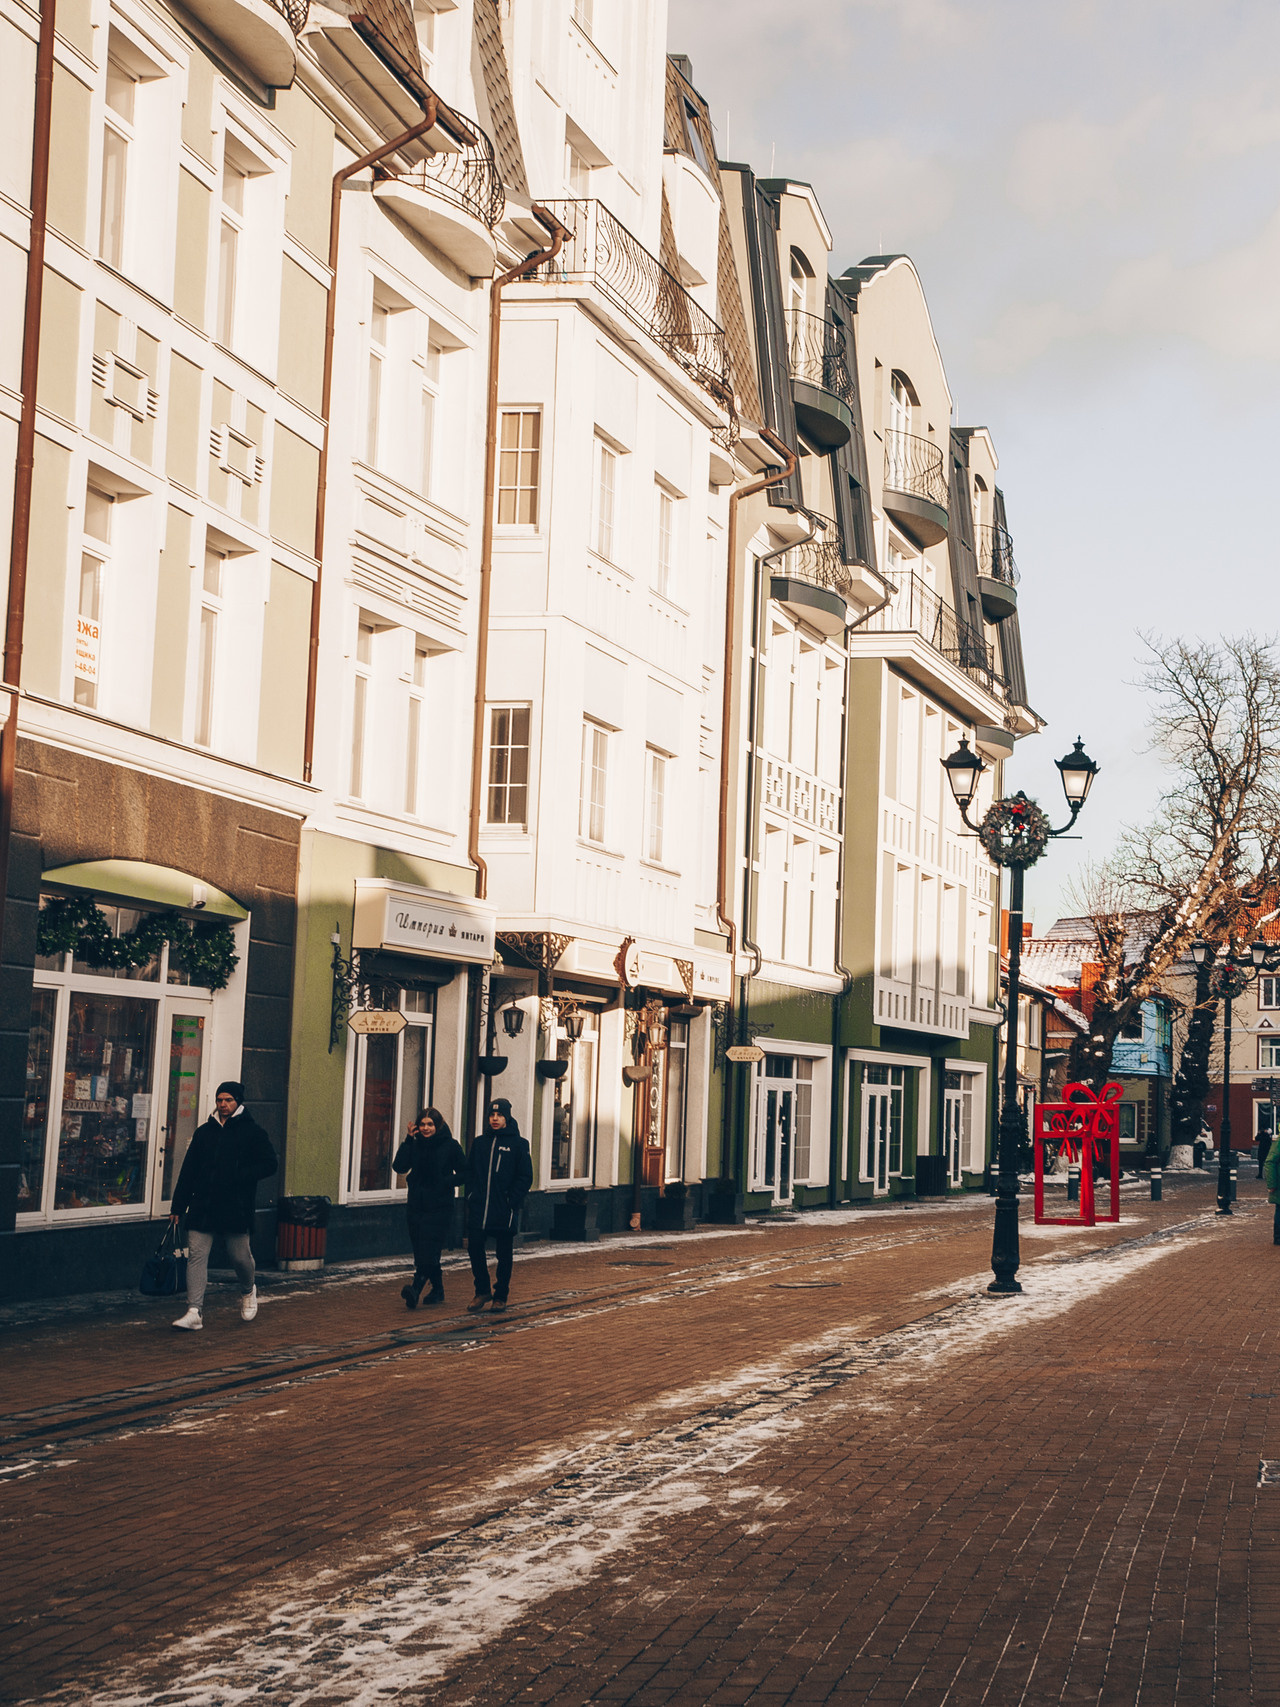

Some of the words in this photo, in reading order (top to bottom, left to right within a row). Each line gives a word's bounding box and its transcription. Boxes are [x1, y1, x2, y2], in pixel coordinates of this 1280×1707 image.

[395, 912, 446, 938] Империя
[460, 931, 485, 943] ЯНТАРЯ
[358, 1016, 397, 1027] Amber
